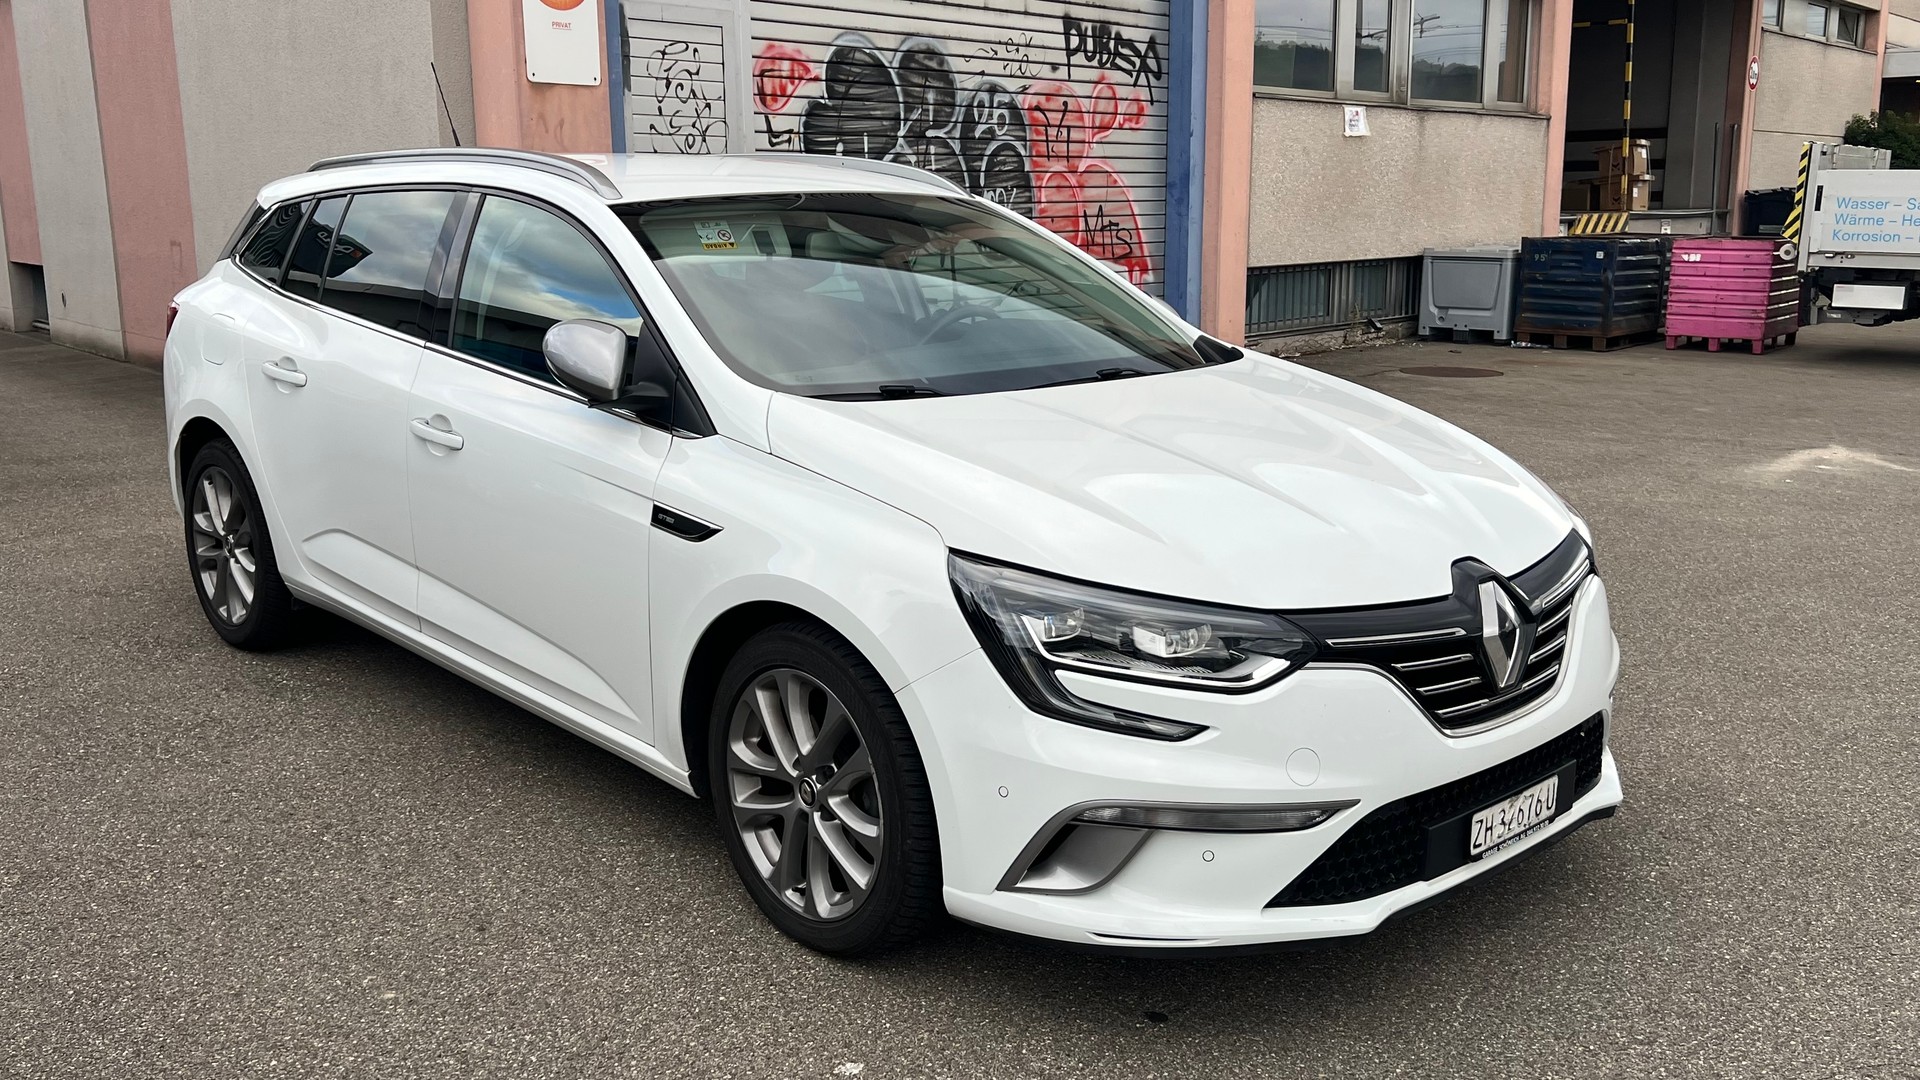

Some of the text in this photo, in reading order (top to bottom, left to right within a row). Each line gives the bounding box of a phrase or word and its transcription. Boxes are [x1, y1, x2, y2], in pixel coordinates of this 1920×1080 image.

[551, 21, 571, 29] PRIVAT
[1836, 197, 1890, 210] Wasser
[1835, 213, 1884, 226] Wärme
[1083, 204, 1133, 260] MTS
[1832, 229, 1901, 242] Korrosion
